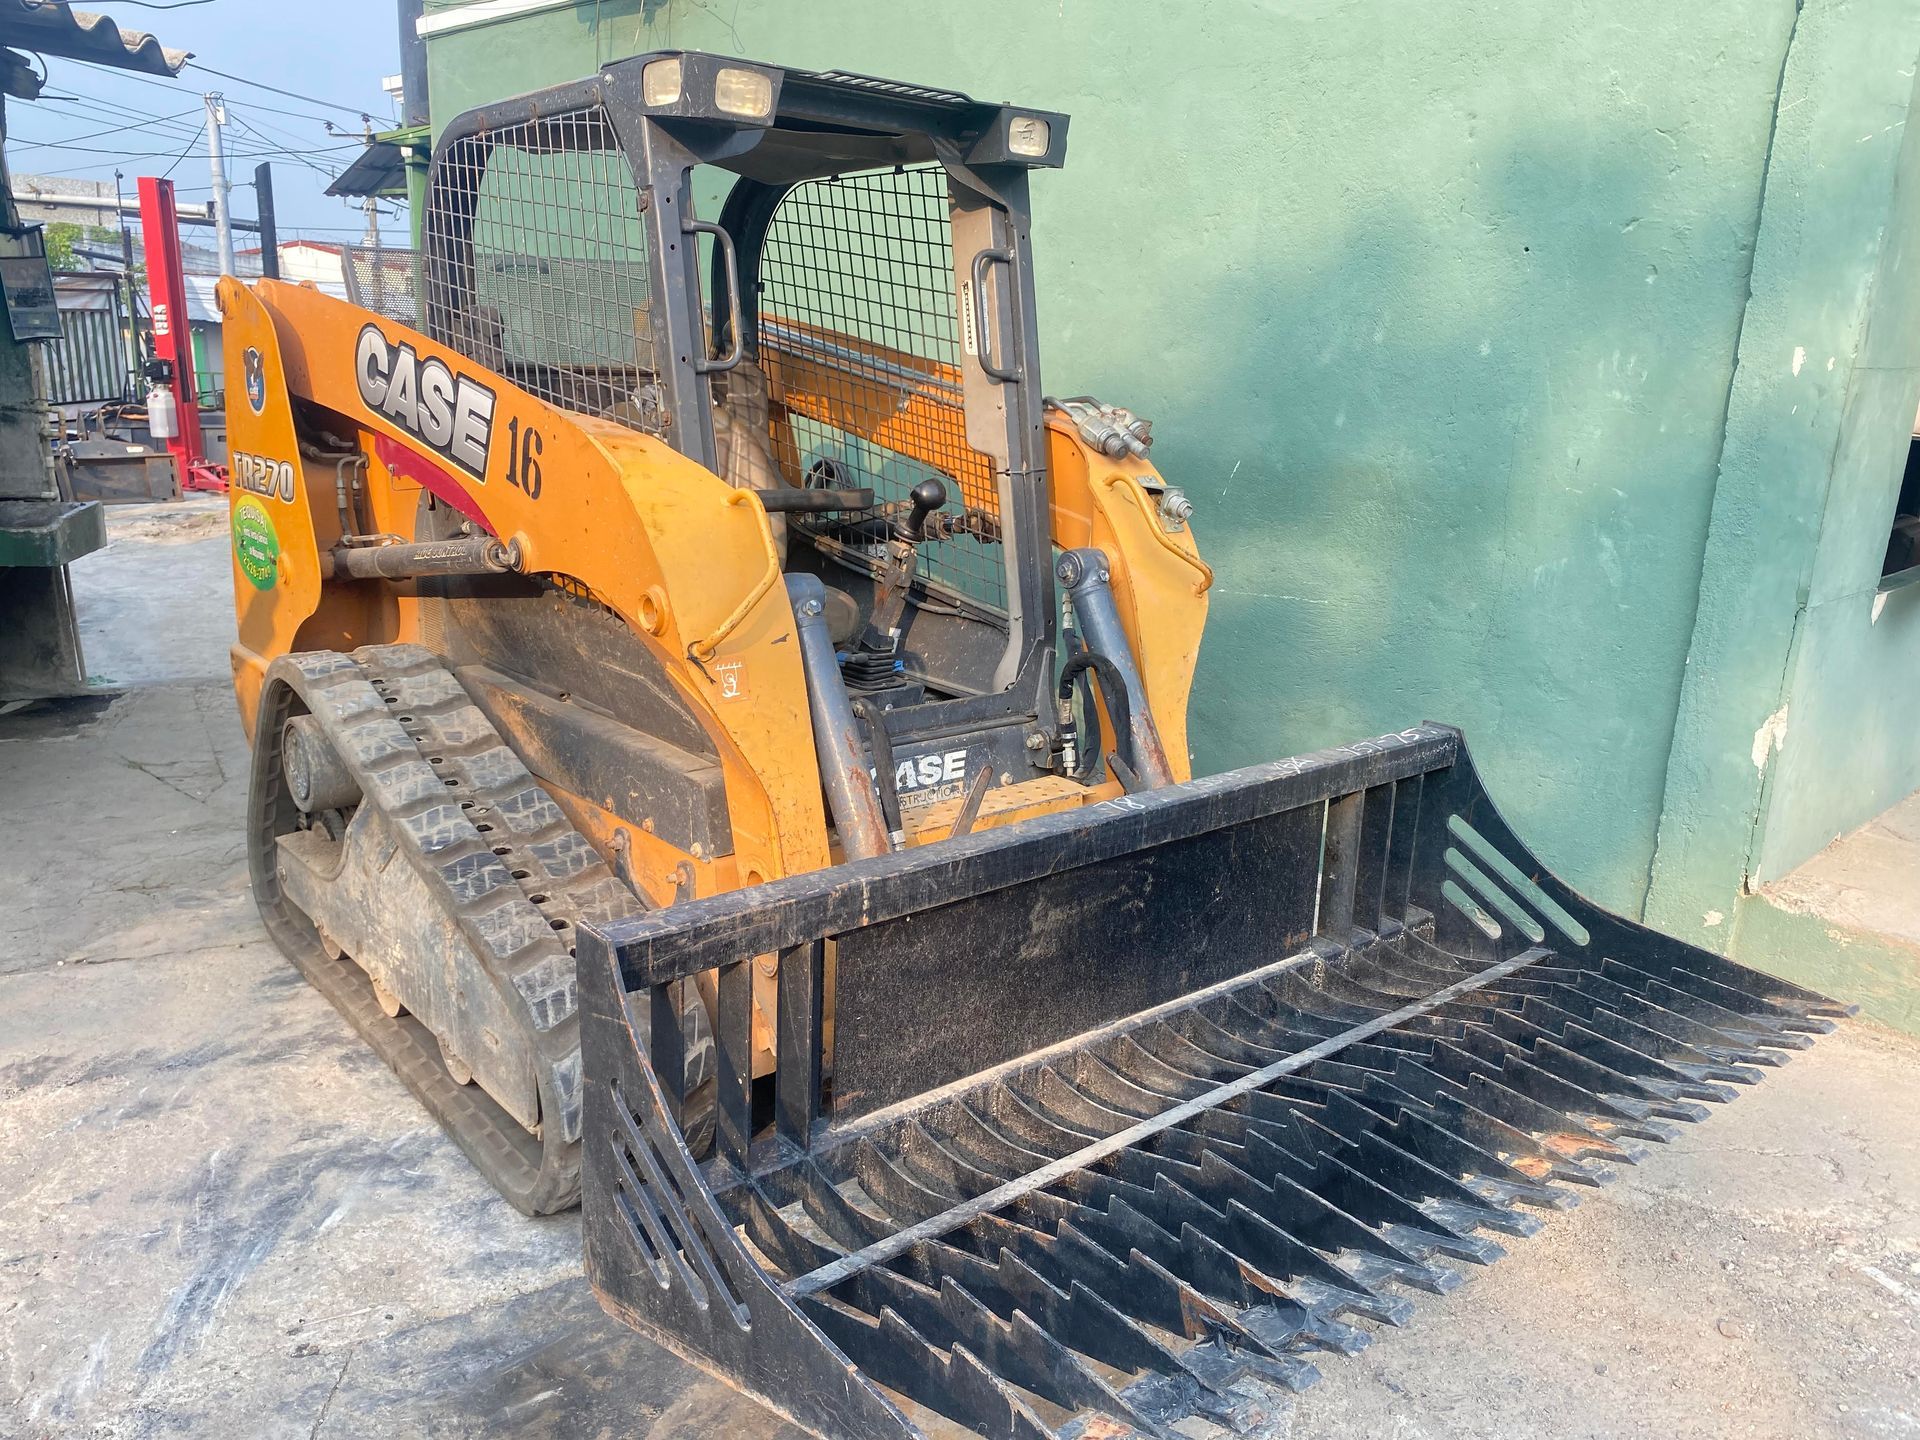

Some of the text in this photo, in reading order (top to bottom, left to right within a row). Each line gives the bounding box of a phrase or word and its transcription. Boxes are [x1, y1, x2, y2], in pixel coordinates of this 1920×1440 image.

[356, 324, 495, 476] CASE
[233, 451, 295, 502] TR270
[506, 416, 543, 500] 16
